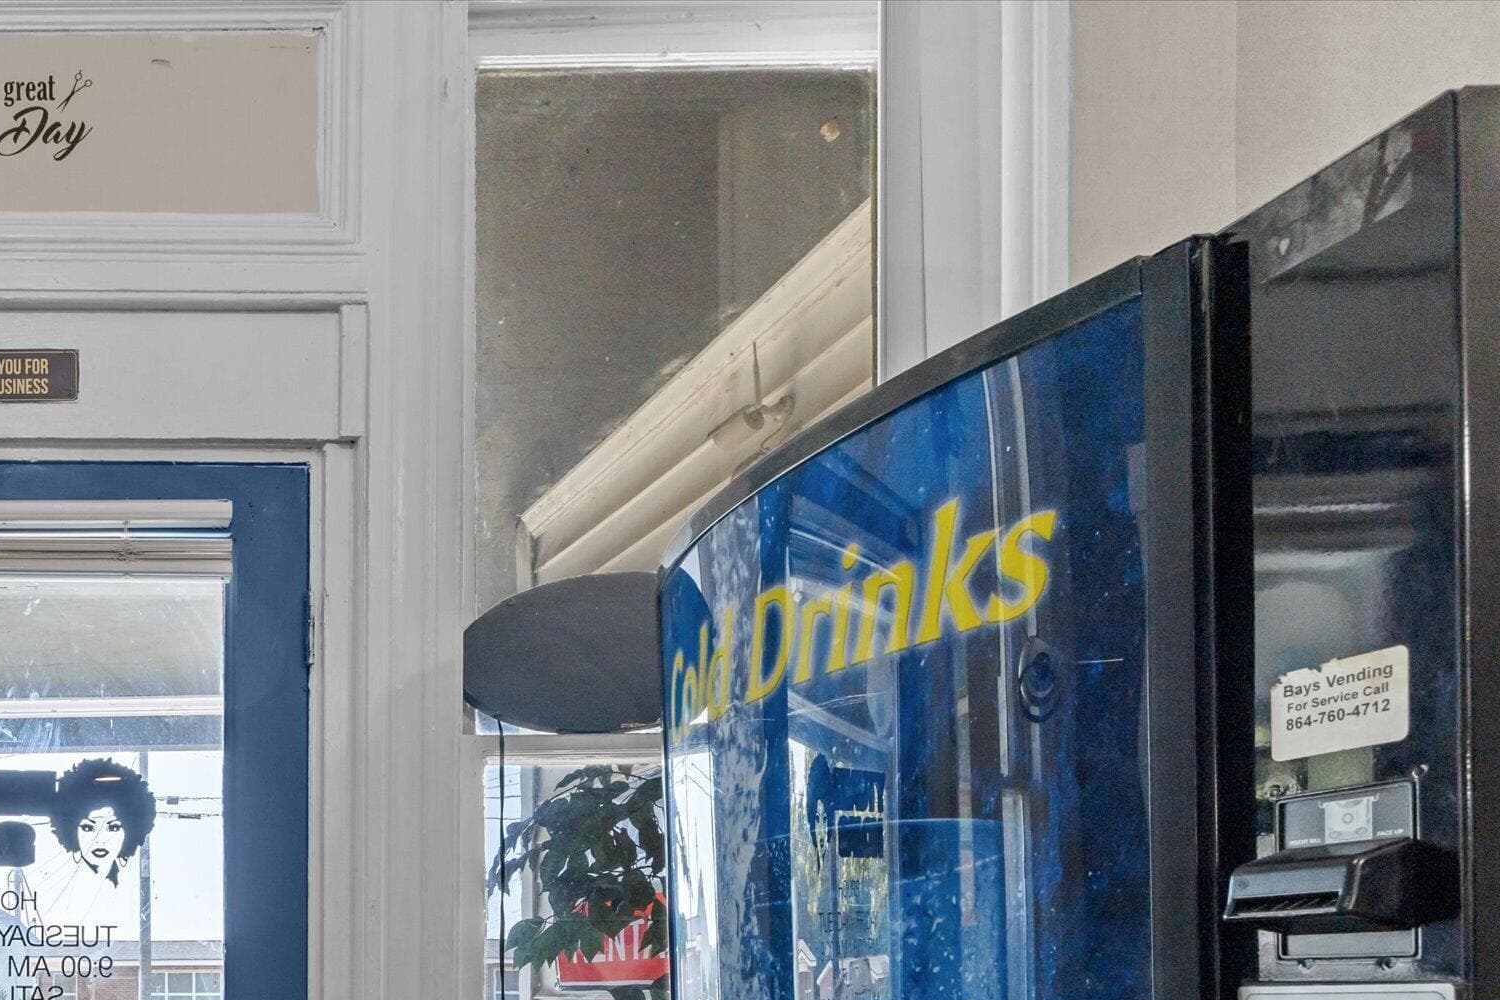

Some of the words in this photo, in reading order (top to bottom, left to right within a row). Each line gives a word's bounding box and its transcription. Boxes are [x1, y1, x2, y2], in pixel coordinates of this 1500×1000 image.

[4, 75, 55, 107] great
[25, 358, 48, 375] FOR
[669, 607, 735, 742] Cold
[747, 497, 1057, 705] Drinks
[1283, 681, 1320, 698] Bays
[1326, 664, 1393, 688] Vending
[1287, 701, 1307, 713] For
[1311, 691, 1358, 708] Service
[1363, 682, 1389, 696] Call
[1286, 698, 1390, 731] 864-760-4712
